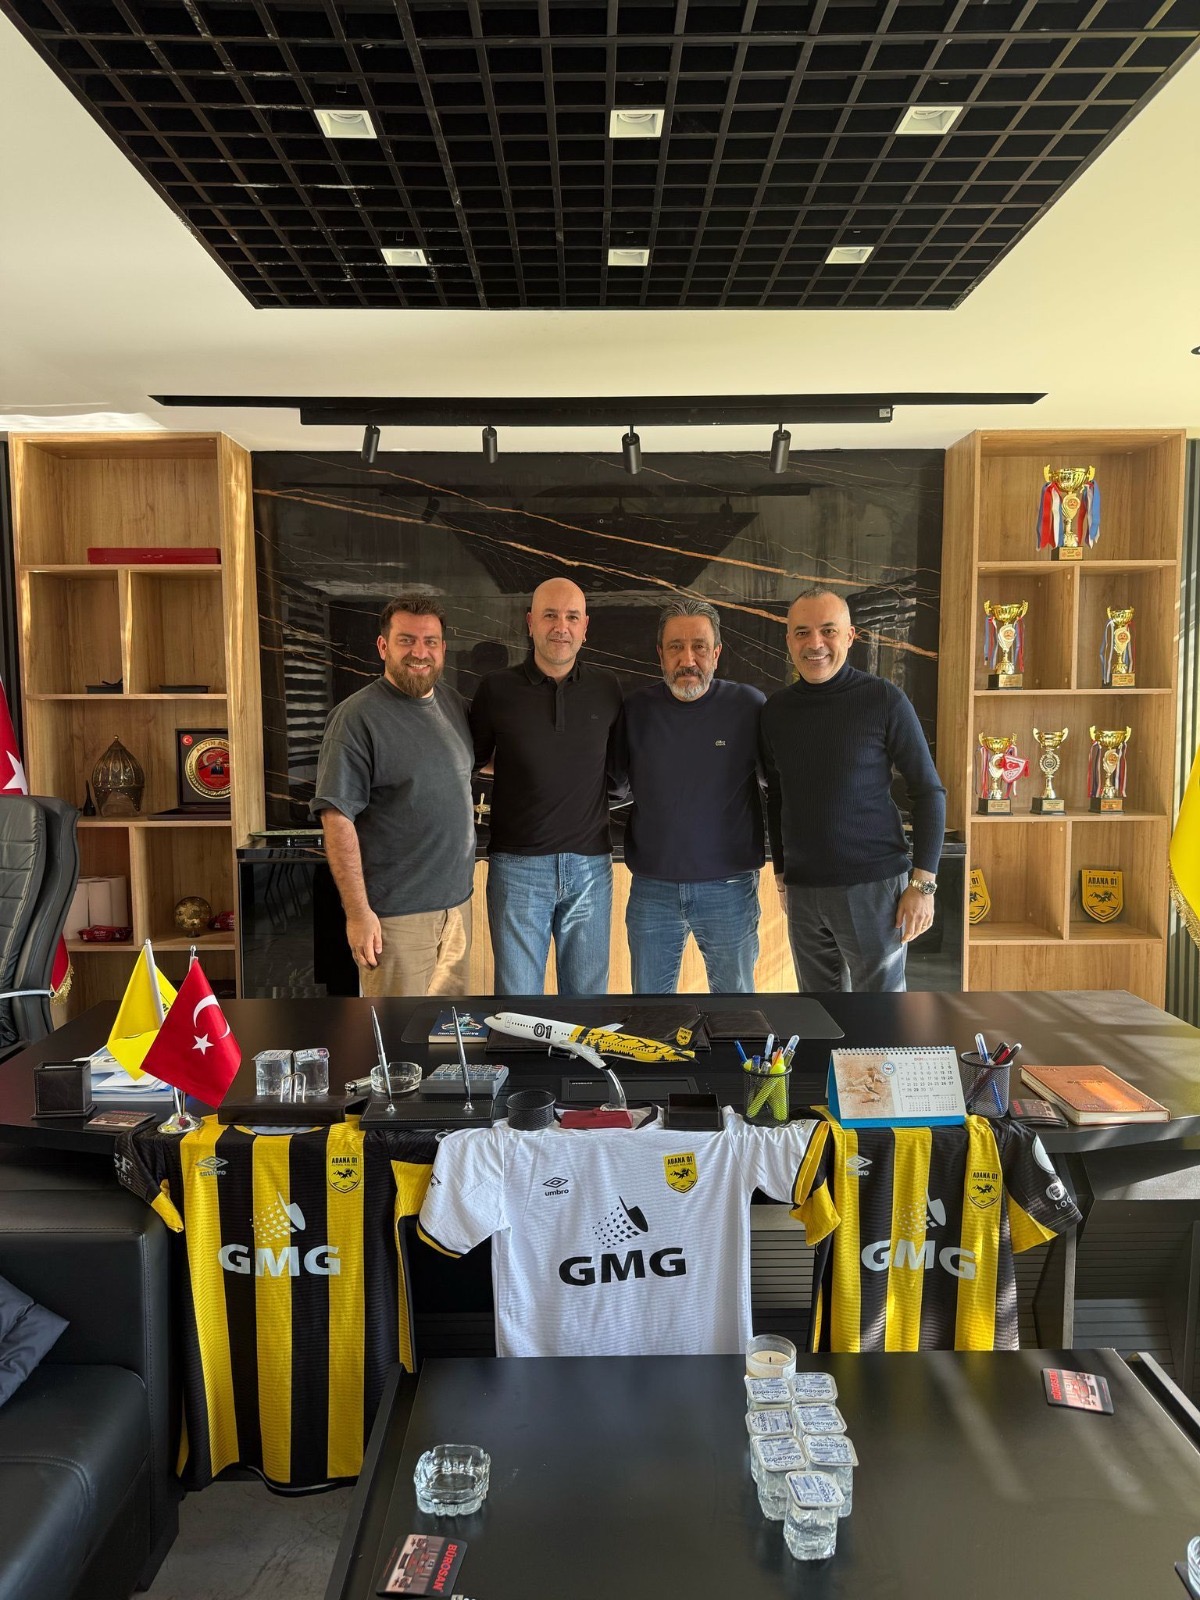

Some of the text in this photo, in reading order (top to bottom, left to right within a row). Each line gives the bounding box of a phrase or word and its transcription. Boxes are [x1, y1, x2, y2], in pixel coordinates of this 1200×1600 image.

[533, 1022, 552, 1040] 01
[218, 1243, 340, 1277] GMG
[558, 1247, 686, 1286] GMG
[861, 1238, 976, 1280] GMG
[432, 1543, 458, 1592] BÜROSAN
